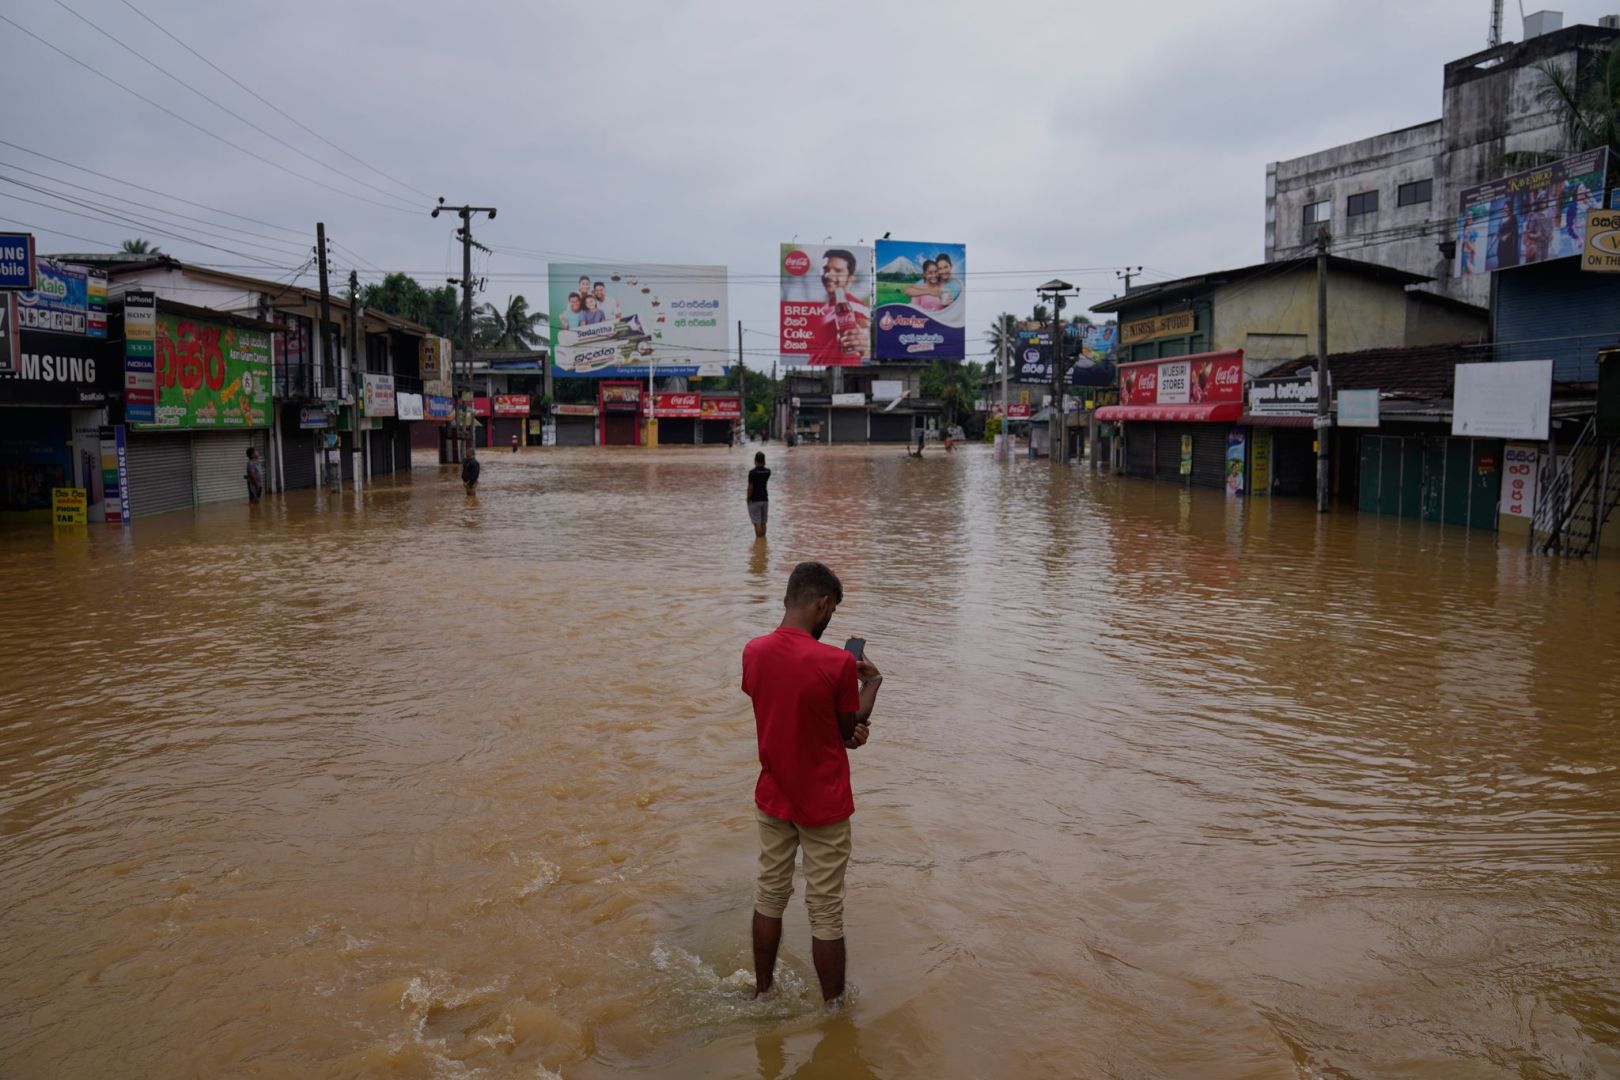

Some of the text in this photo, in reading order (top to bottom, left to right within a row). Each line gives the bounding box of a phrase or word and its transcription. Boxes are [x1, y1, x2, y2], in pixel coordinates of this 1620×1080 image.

[1588, 255, 1602, 265] ON
[784, 305, 825, 315] BREAK
[1161, 314, 1189, 330] STUDIO
[577, 326, 612, 338] Sudantha
[783, 328, 814, 339] Coke
[0, 353, 96, 383] MSUNG
[1161, 365, 1187, 377] WIJESIRI
[1215, 364, 1240, 386] Coca-Cola
[1138, 373, 1156, 390] Coca-Cola
[1162, 378, 1185, 390] STORES
[670, 396, 695, 406] Coca-Cola
[118, 447, 130, 519] SAMSUNG
